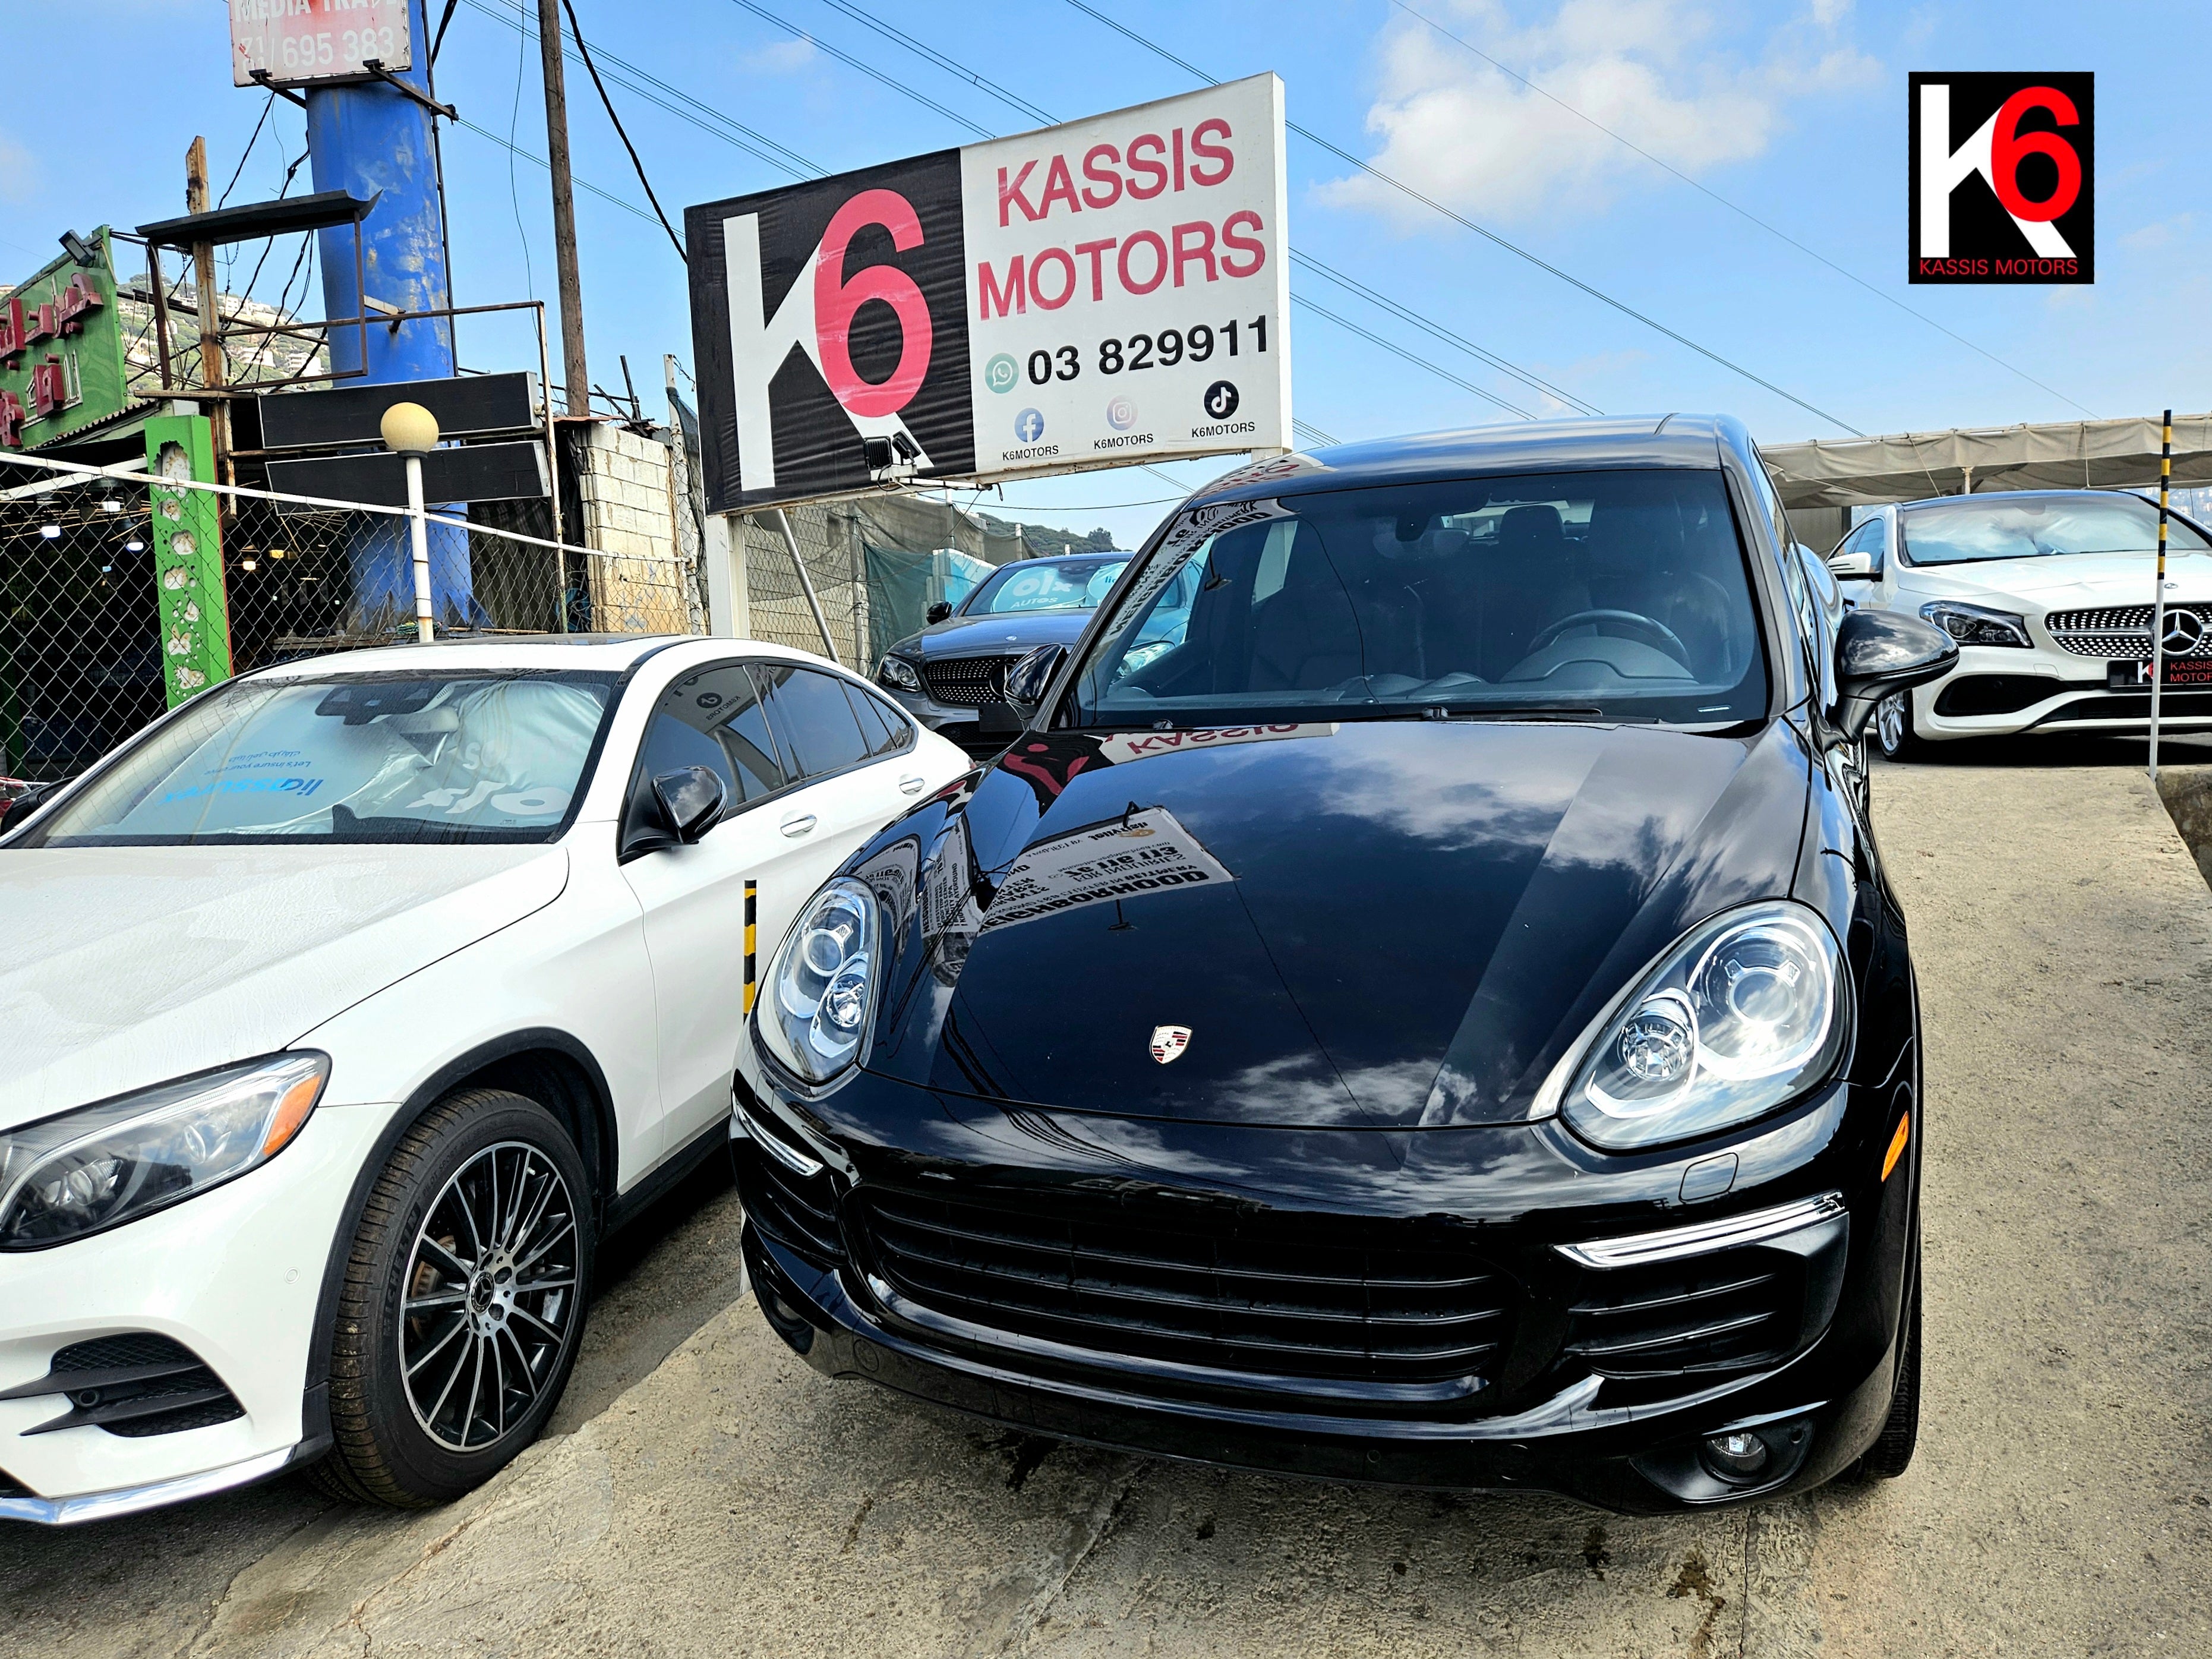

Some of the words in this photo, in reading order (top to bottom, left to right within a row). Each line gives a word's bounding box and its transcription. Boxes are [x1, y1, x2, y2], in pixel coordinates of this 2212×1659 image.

[282, 32, 333, 68] 695
[342, 27, 395, 62] 383
[997, 118, 1234, 227] KASSIS
[978, 210, 1266, 321] MOTORS
[722, 188, 934, 492] K6
[1027, 345, 1081, 386] 03
[1098, 314, 1269, 375] 829911
[1191, 421, 1256, 439] K6MOTORS
[1093, 433, 1154, 450] K6MOTORS
[1002, 444, 1059, 462] K6MOTORS
[1012, 575, 1073, 597] olx
[1011, 597, 1058, 609] AUTOS
[2170, 661, 2212, 671] KASSIS
